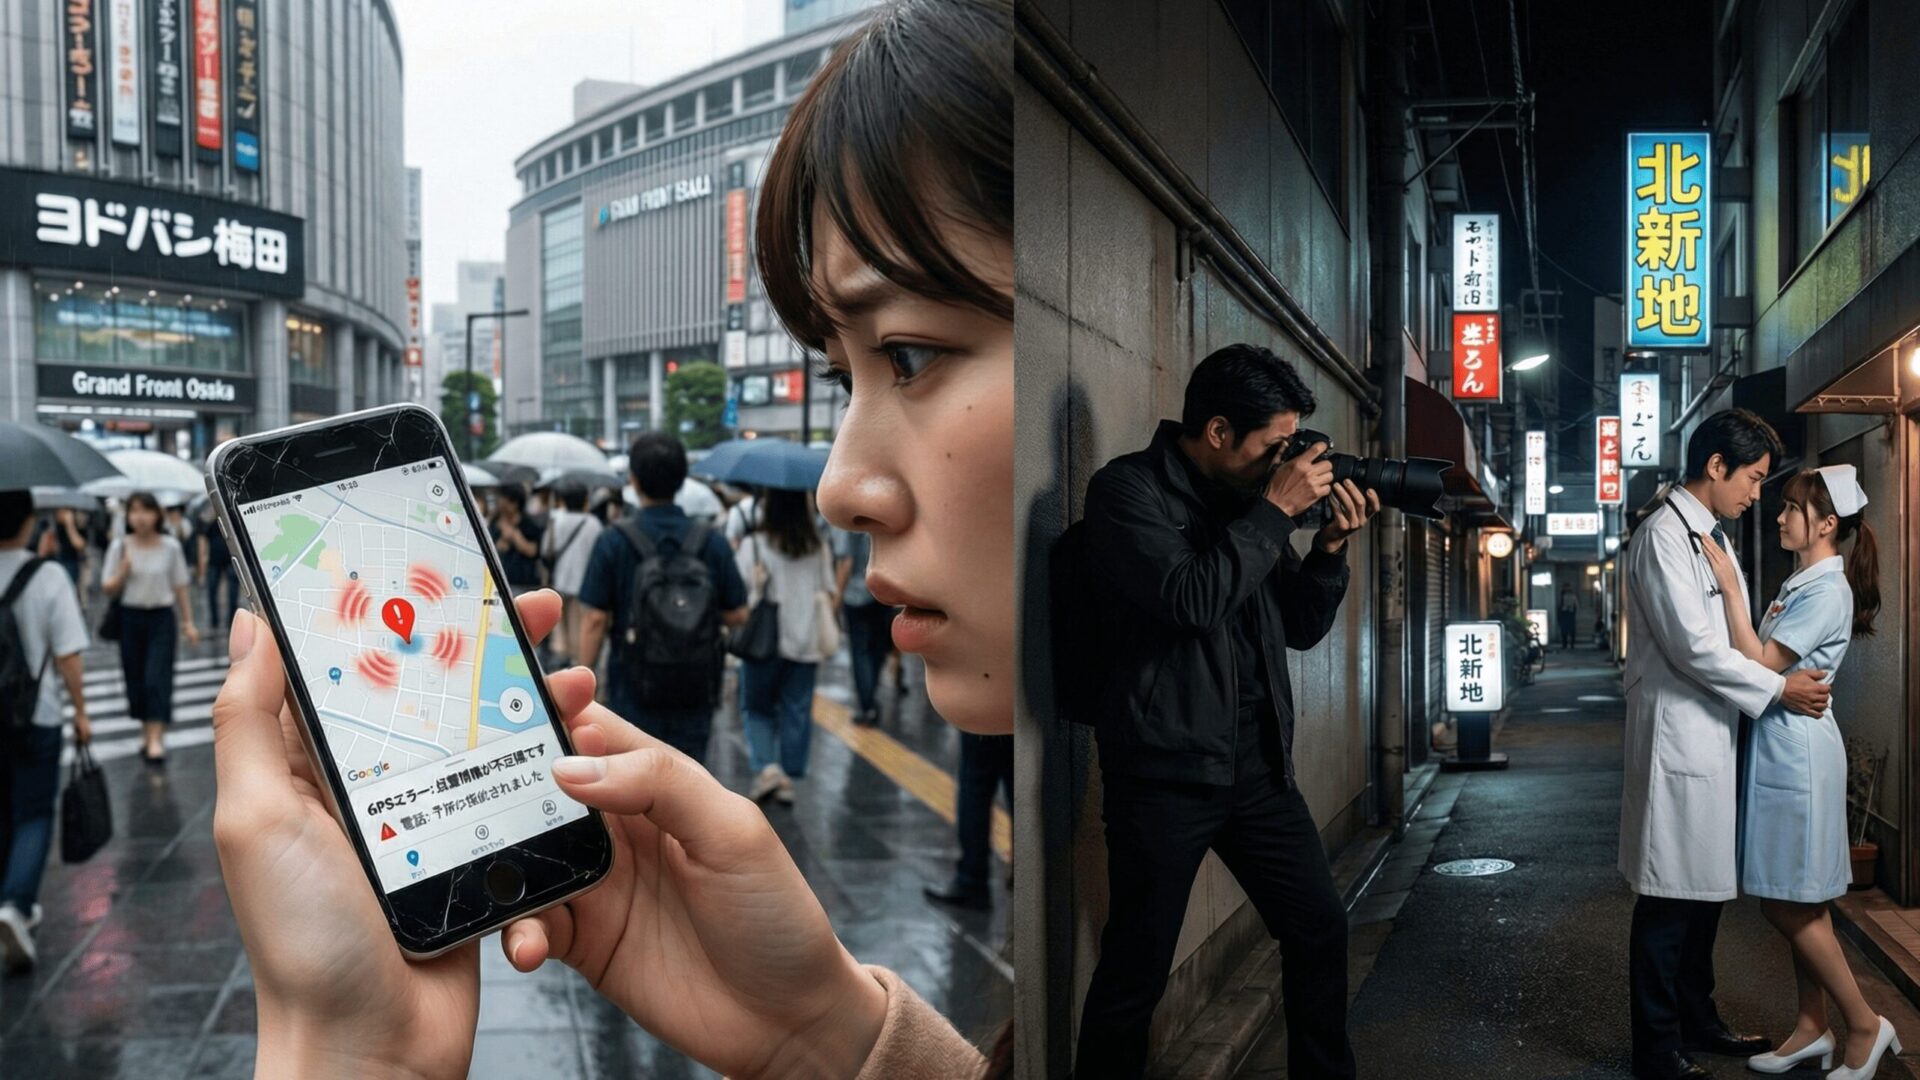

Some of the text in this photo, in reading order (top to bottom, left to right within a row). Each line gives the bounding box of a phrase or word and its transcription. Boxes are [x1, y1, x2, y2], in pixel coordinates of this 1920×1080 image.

[36, 193, 288, 275] ヨドバシ梅田
[1635, 142, 1702, 336] 北新地
[72, 370, 235, 401] Grand Front Osaka
[1459, 633, 1484, 703] 北新地
[347, 761, 391, 782] Google
